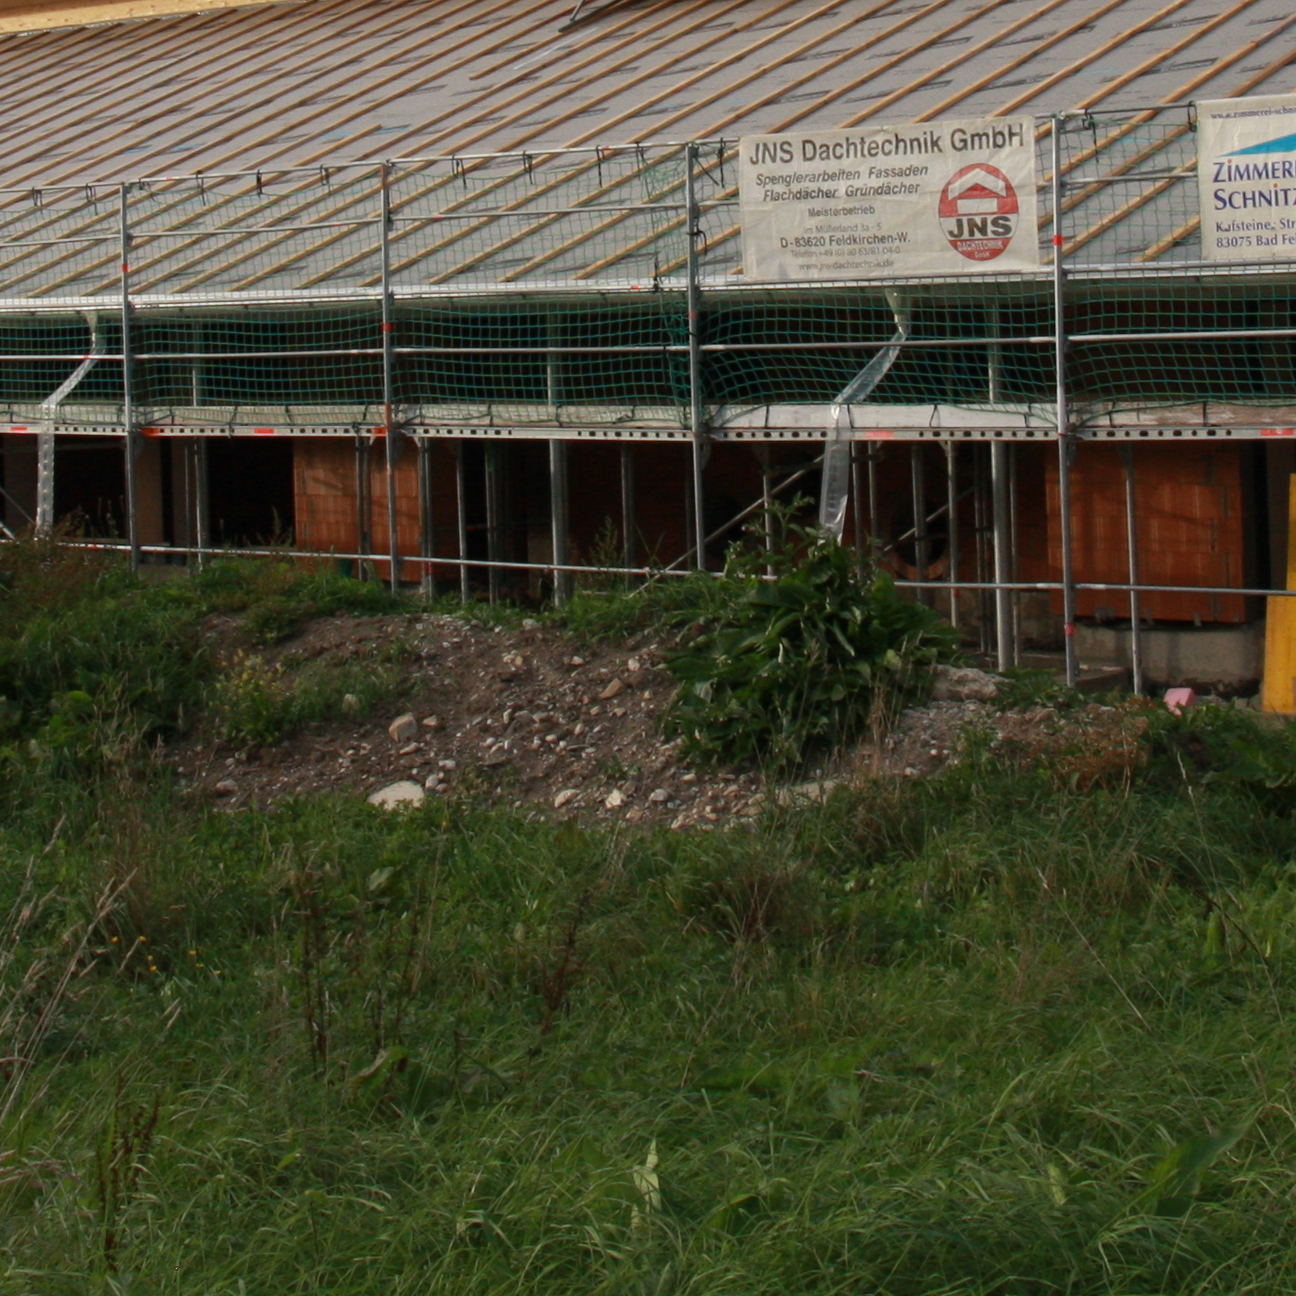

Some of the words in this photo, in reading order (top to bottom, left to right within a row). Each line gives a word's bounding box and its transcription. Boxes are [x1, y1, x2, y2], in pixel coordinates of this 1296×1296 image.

[749, 140, 794, 165] JNS
[802, 131, 943, 162] Dachtechnik
[950, 123, 1024, 152] GmbH
[756, 168, 861, 188] Spenglerarbeiten
[868, 164, 929, 179] Fassaden
[763, 187, 837, 202] Flachdächer
[845, 181, 921, 197] Gründächer
[808, 205, 876, 218] Meisterbetrieb
[948, 215, 1012, 238] JNS
[829, 231, 911, 246] Feldkirchen-W.
[1216, 235, 1252, 248] 83075
[1256, 233, 1278, 247] Bad
